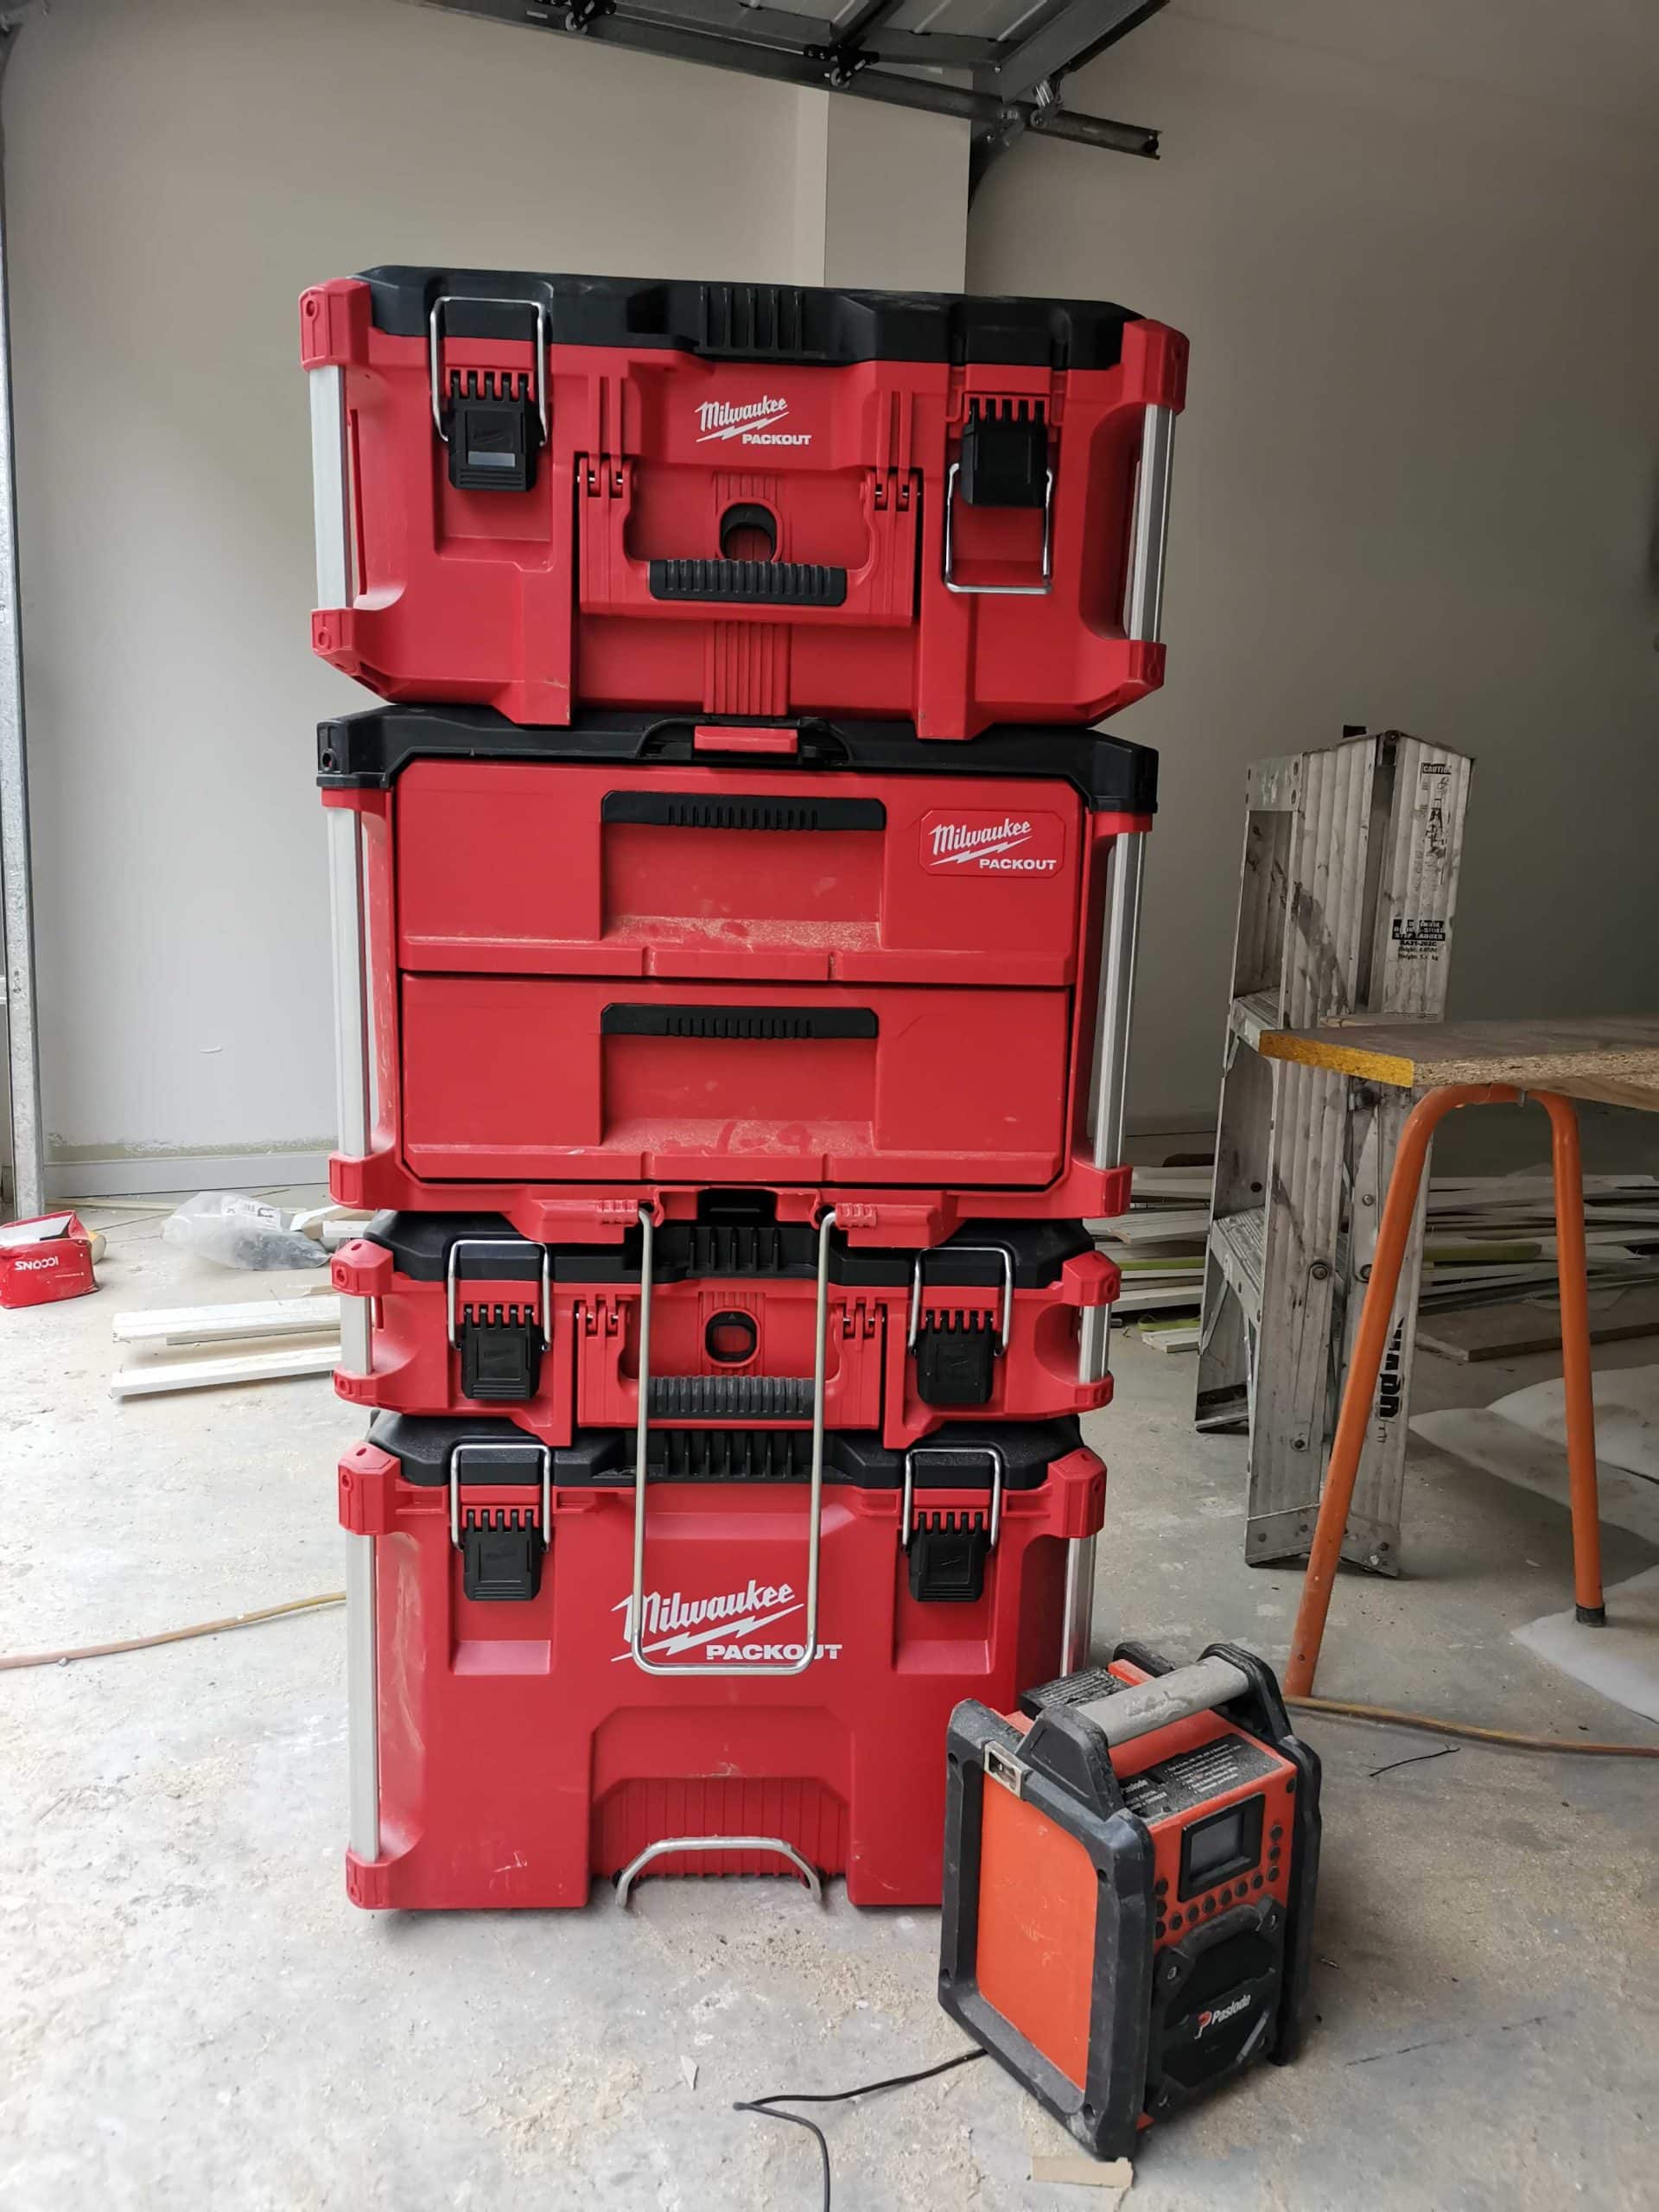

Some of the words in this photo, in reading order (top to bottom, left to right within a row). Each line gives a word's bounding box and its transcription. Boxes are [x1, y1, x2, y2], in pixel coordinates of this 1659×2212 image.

[695, 395, 788, 432] Milwaukee
[742, 435, 812, 445] PACKOUT
[928, 818, 1033, 855] Milwaukee
[979, 859, 1057, 870] PACKOUT
[15, 1256, 59, 1271] ICCONS
[610, 1580, 795, 1643] Milwaukee
[1211, 1994, 1251, 2025] Paslode
